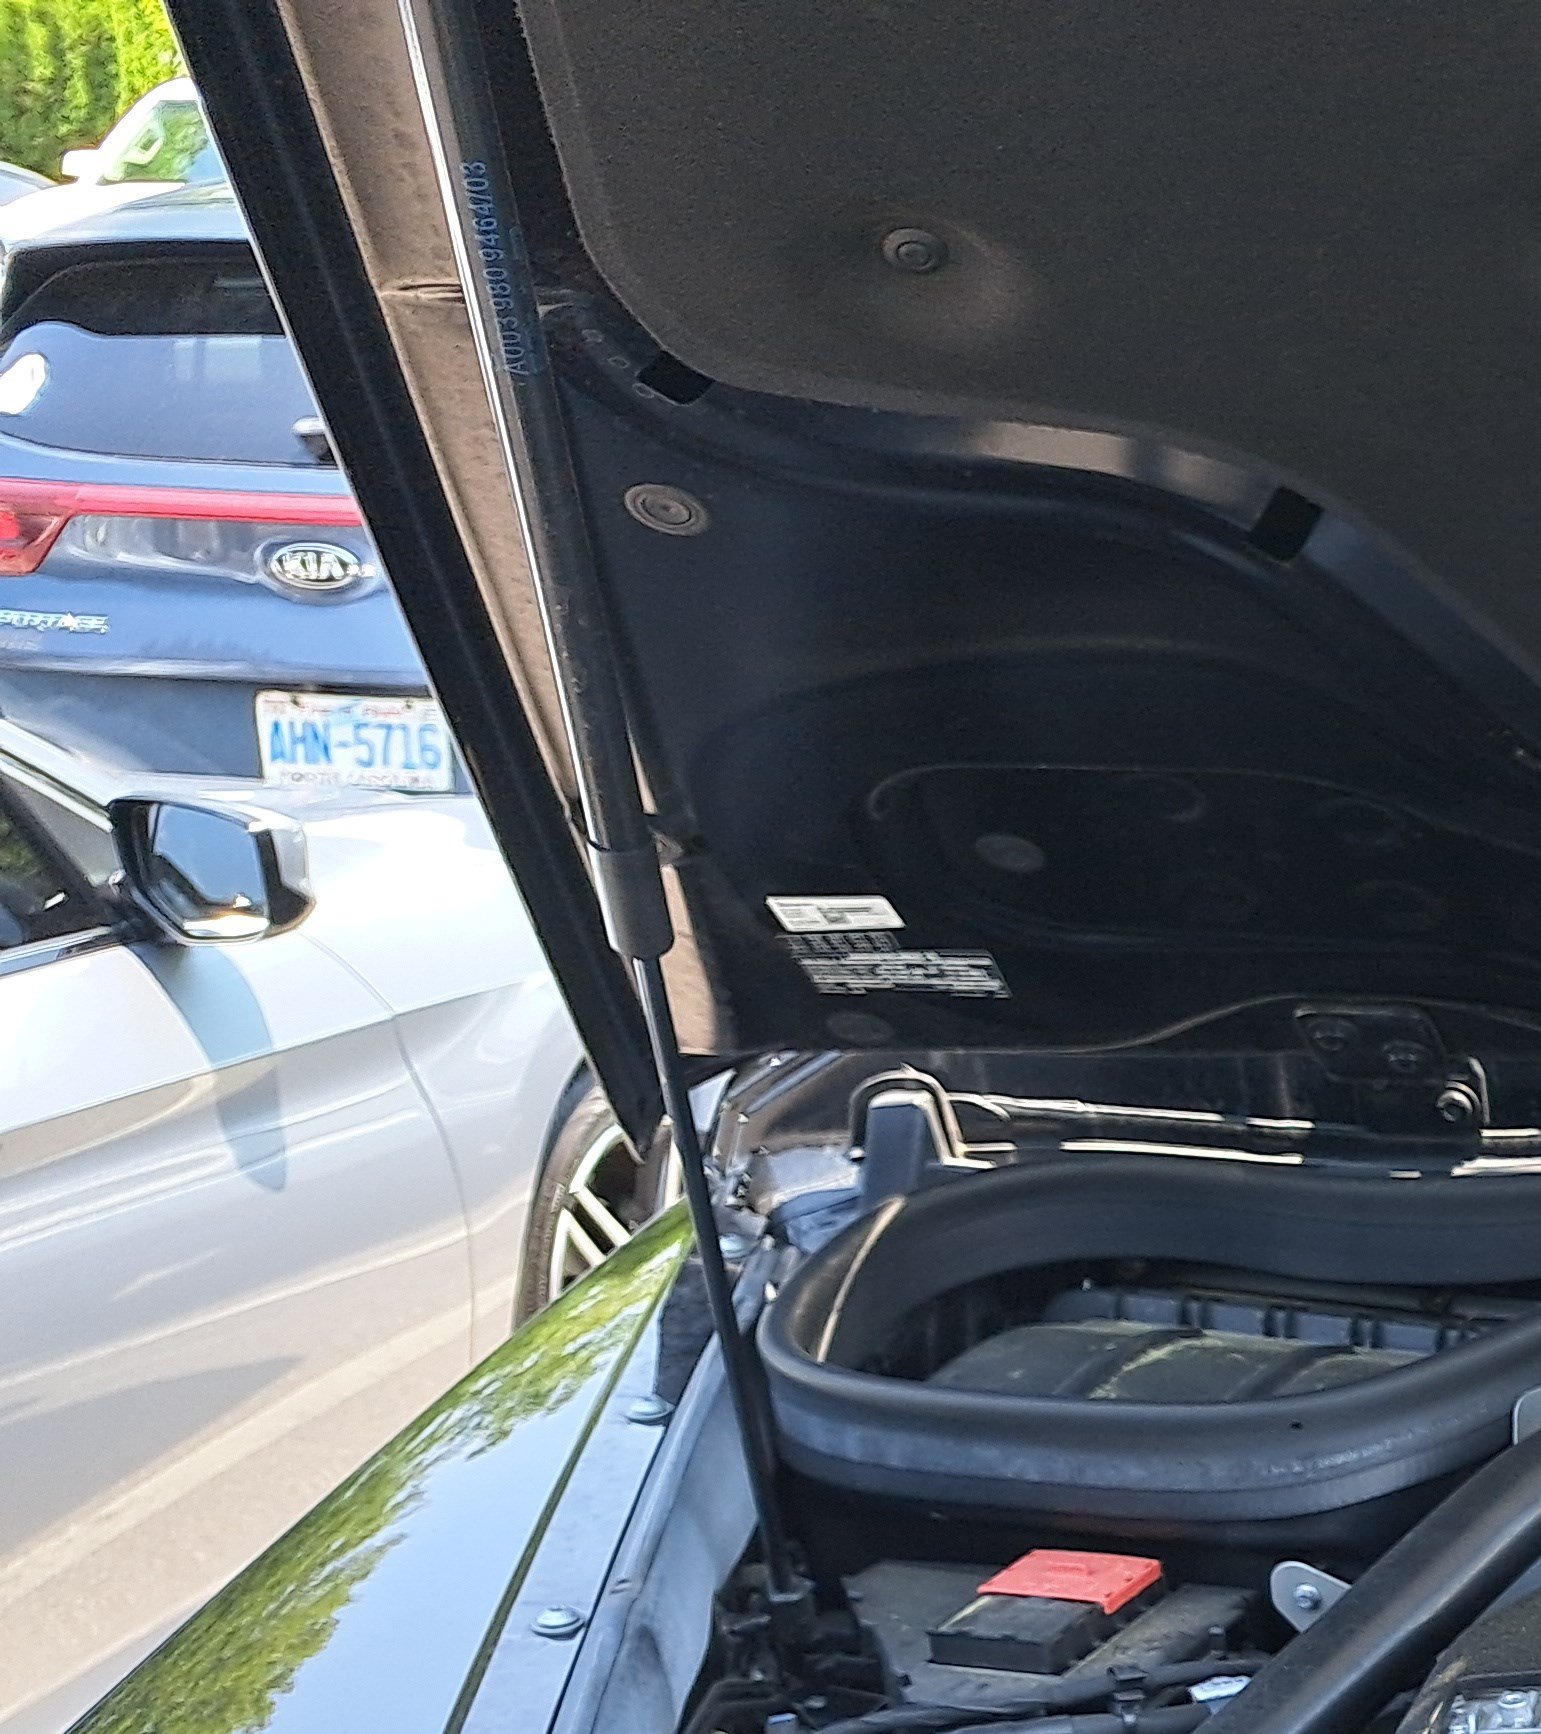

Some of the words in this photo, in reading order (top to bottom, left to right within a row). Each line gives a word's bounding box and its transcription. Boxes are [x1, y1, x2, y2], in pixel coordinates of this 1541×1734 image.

[485, 267, 515, 311] 980
[282, 550, 346, 580] KIA
[270, 718, 443, 770] AHN-5716
